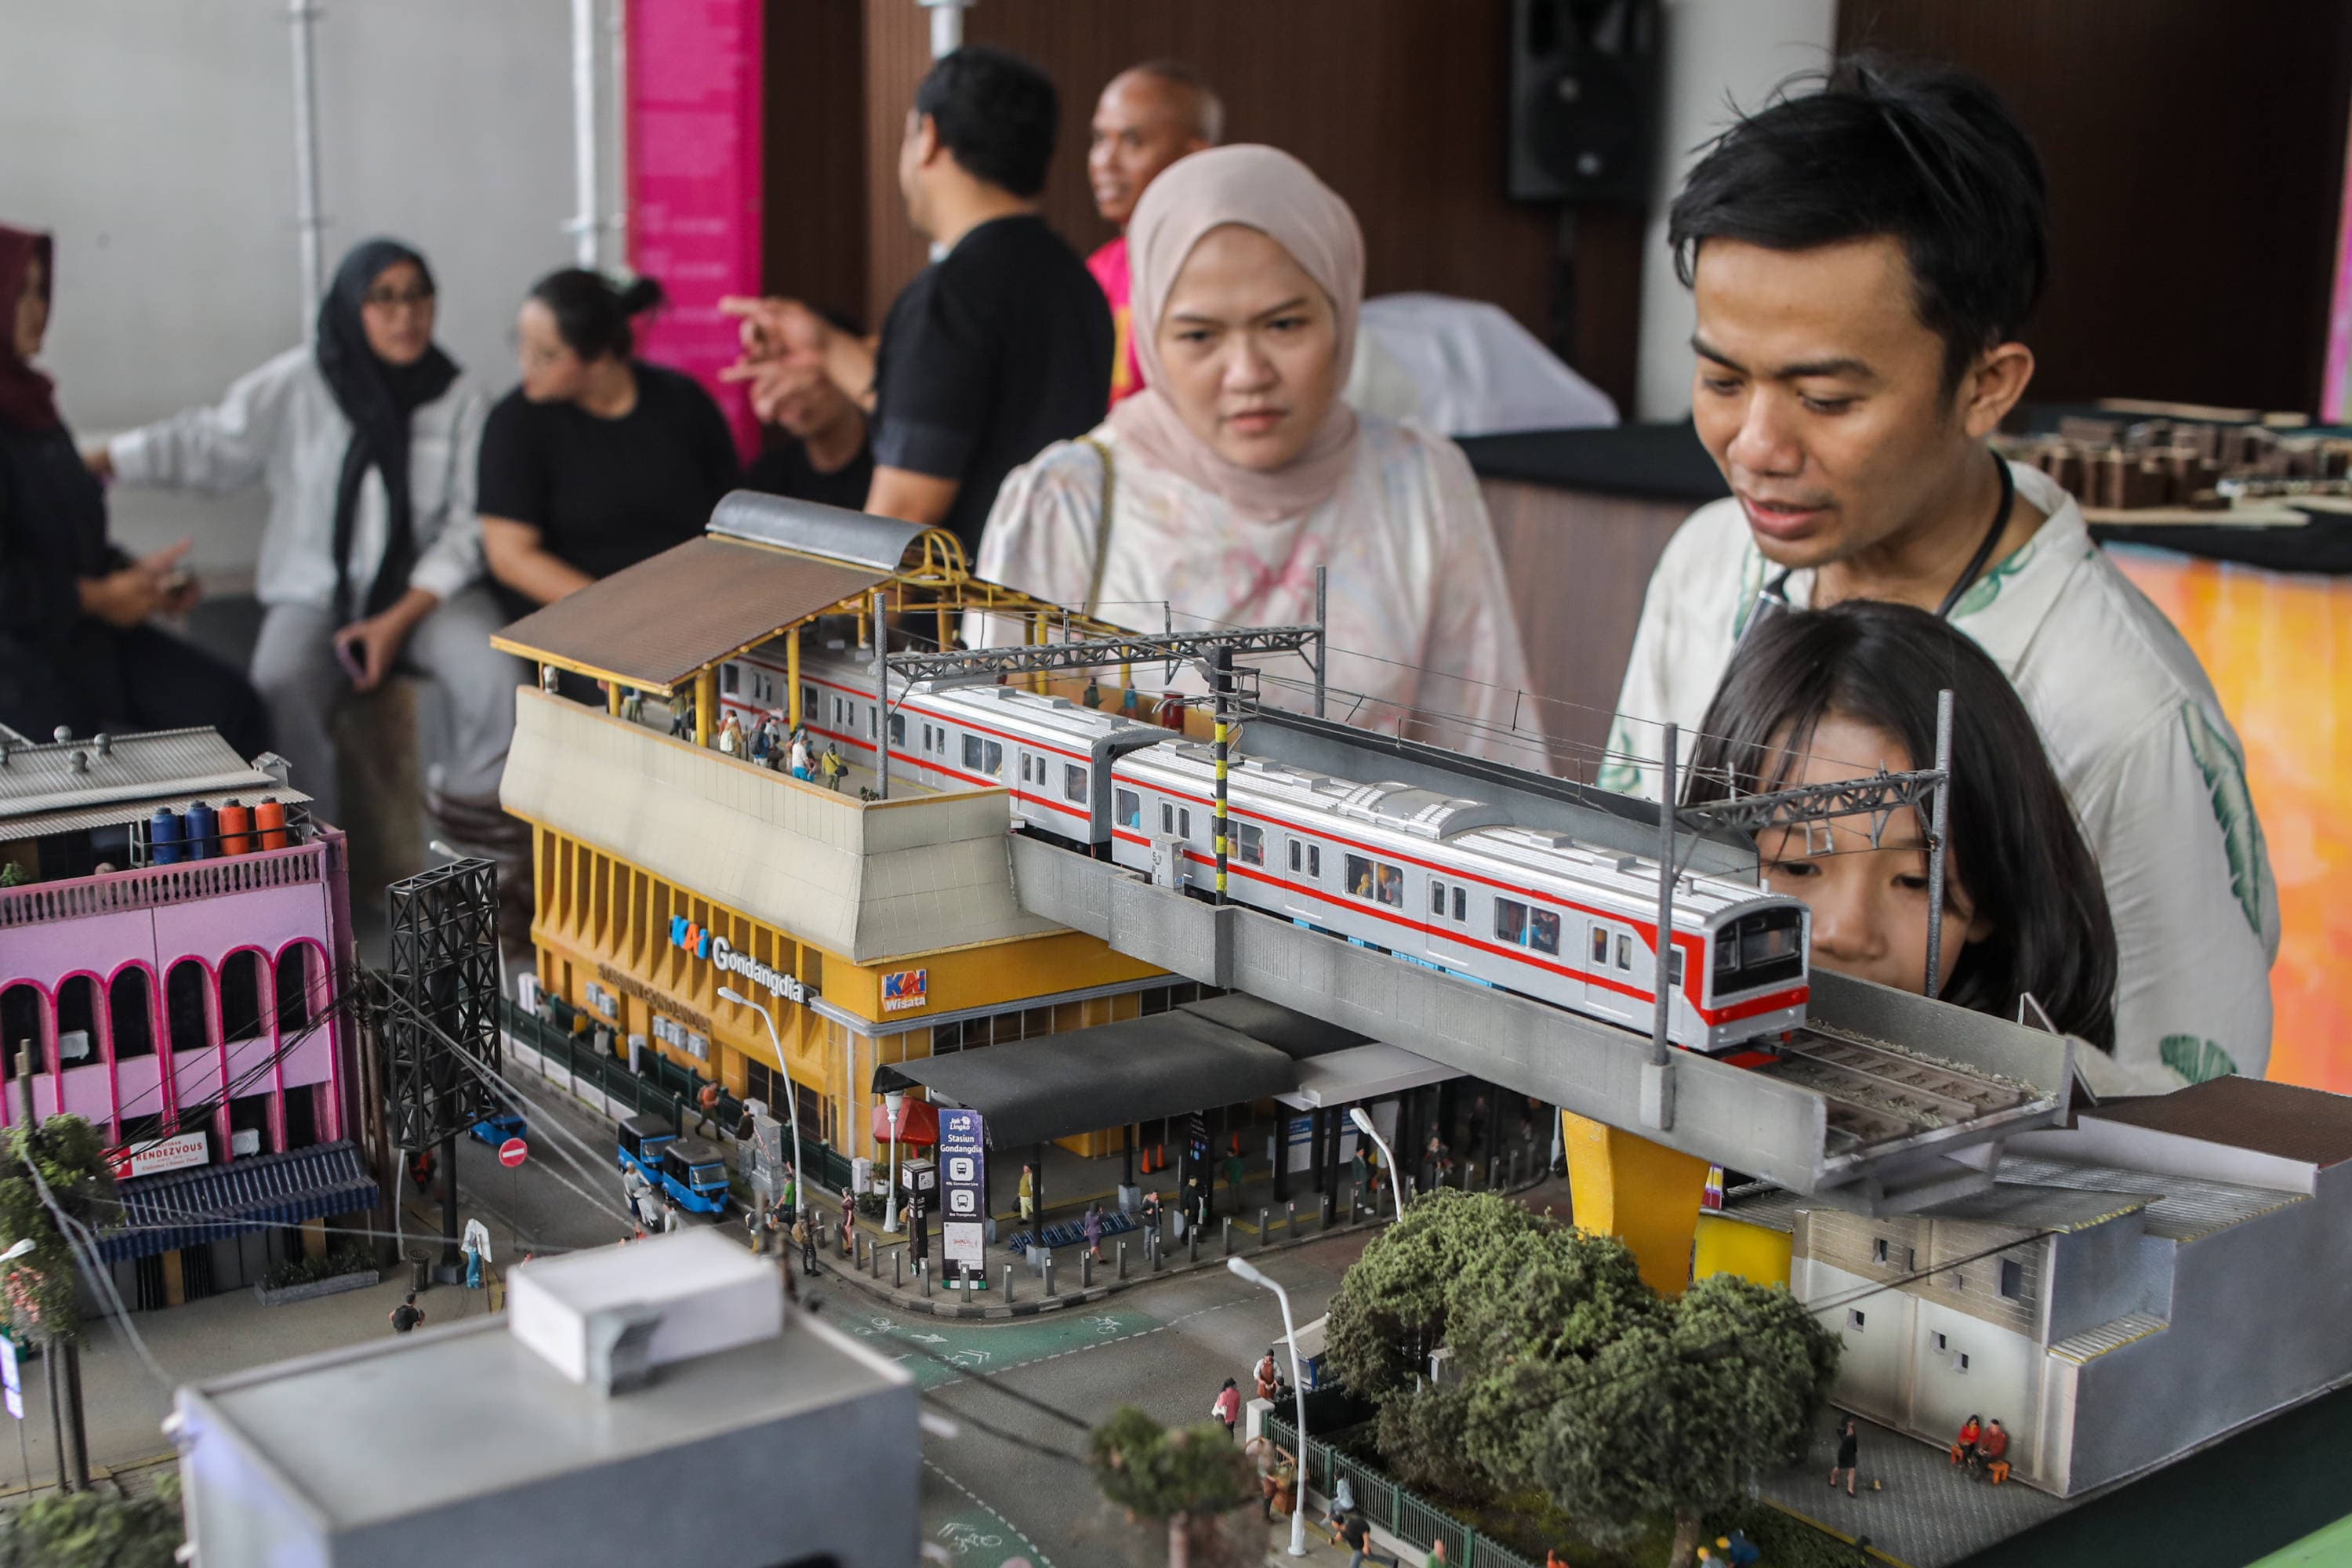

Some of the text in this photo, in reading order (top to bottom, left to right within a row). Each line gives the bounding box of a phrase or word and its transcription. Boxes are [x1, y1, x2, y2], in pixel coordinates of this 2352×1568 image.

[671, 915, 804, 1004] KAI Gondangdia
[884, 968, 927, 999] KAI
[885, 996, 927, 1011] Wisata
[948, 1134, 975, 1142] Stasiun
[136, 1142, 202, 1161] RENDEZVOUS
[940, 1144, 982, 1155] Gondangdia
